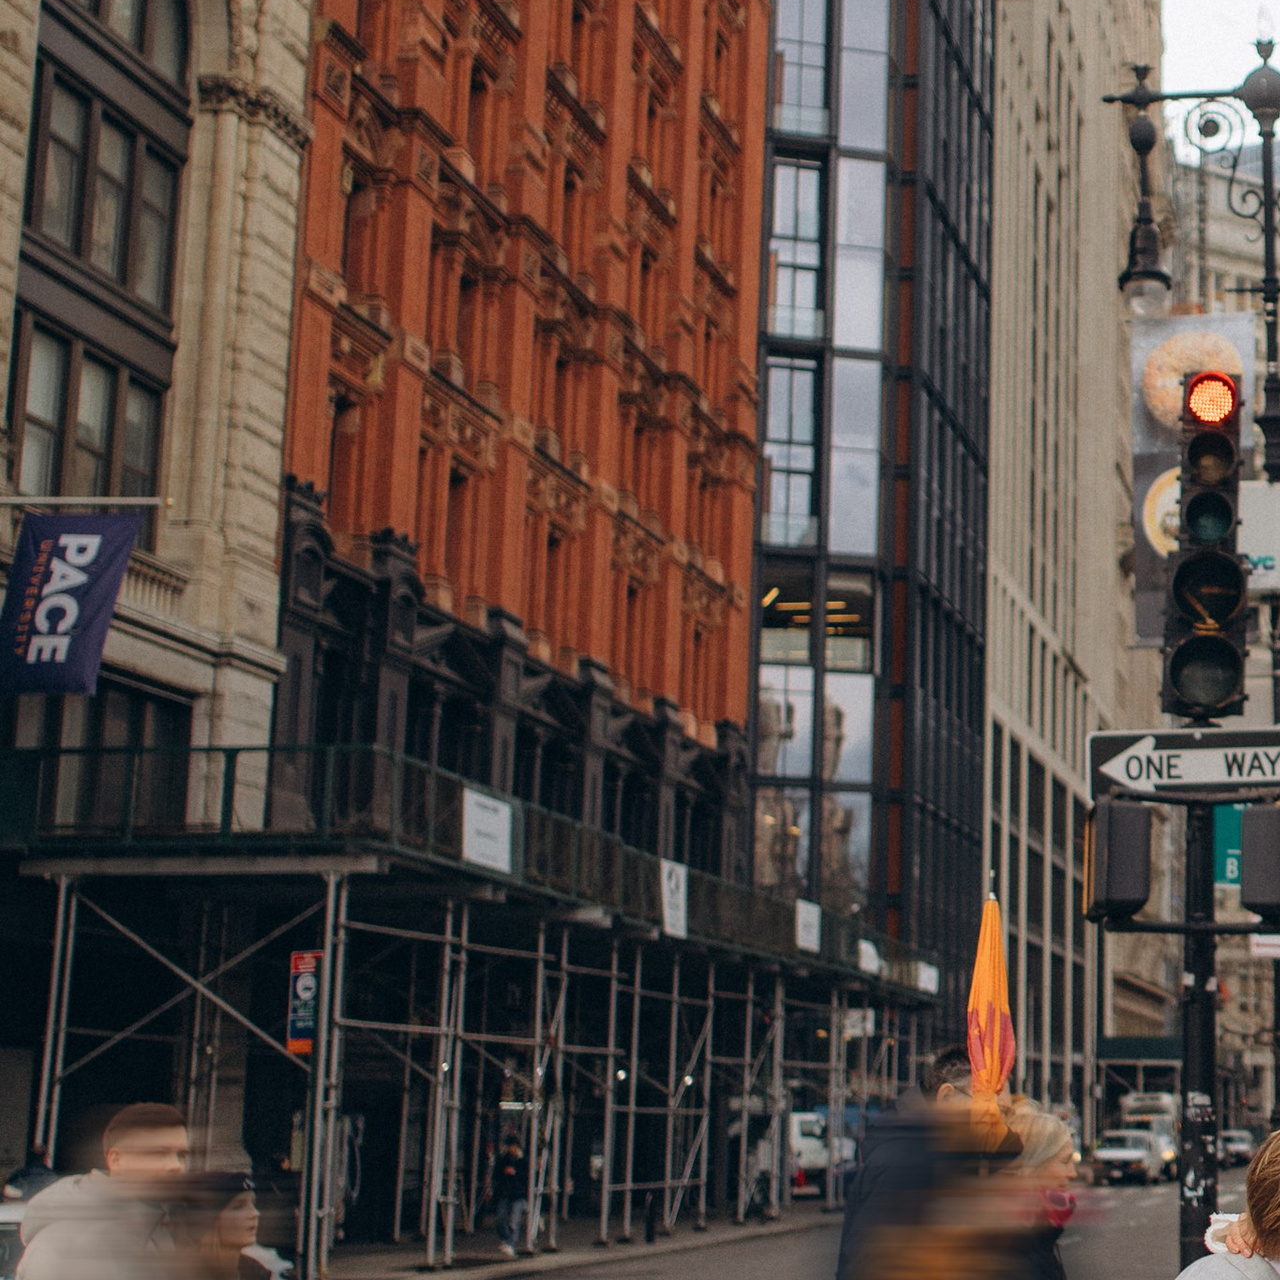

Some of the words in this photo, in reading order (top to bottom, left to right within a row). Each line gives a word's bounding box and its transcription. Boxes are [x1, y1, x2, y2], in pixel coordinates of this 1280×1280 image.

[14, 539, 53, 657] UNIVERSITY
[26, 533, 102, 664] PACE
[1125, 754, 1183, 781] ONE
